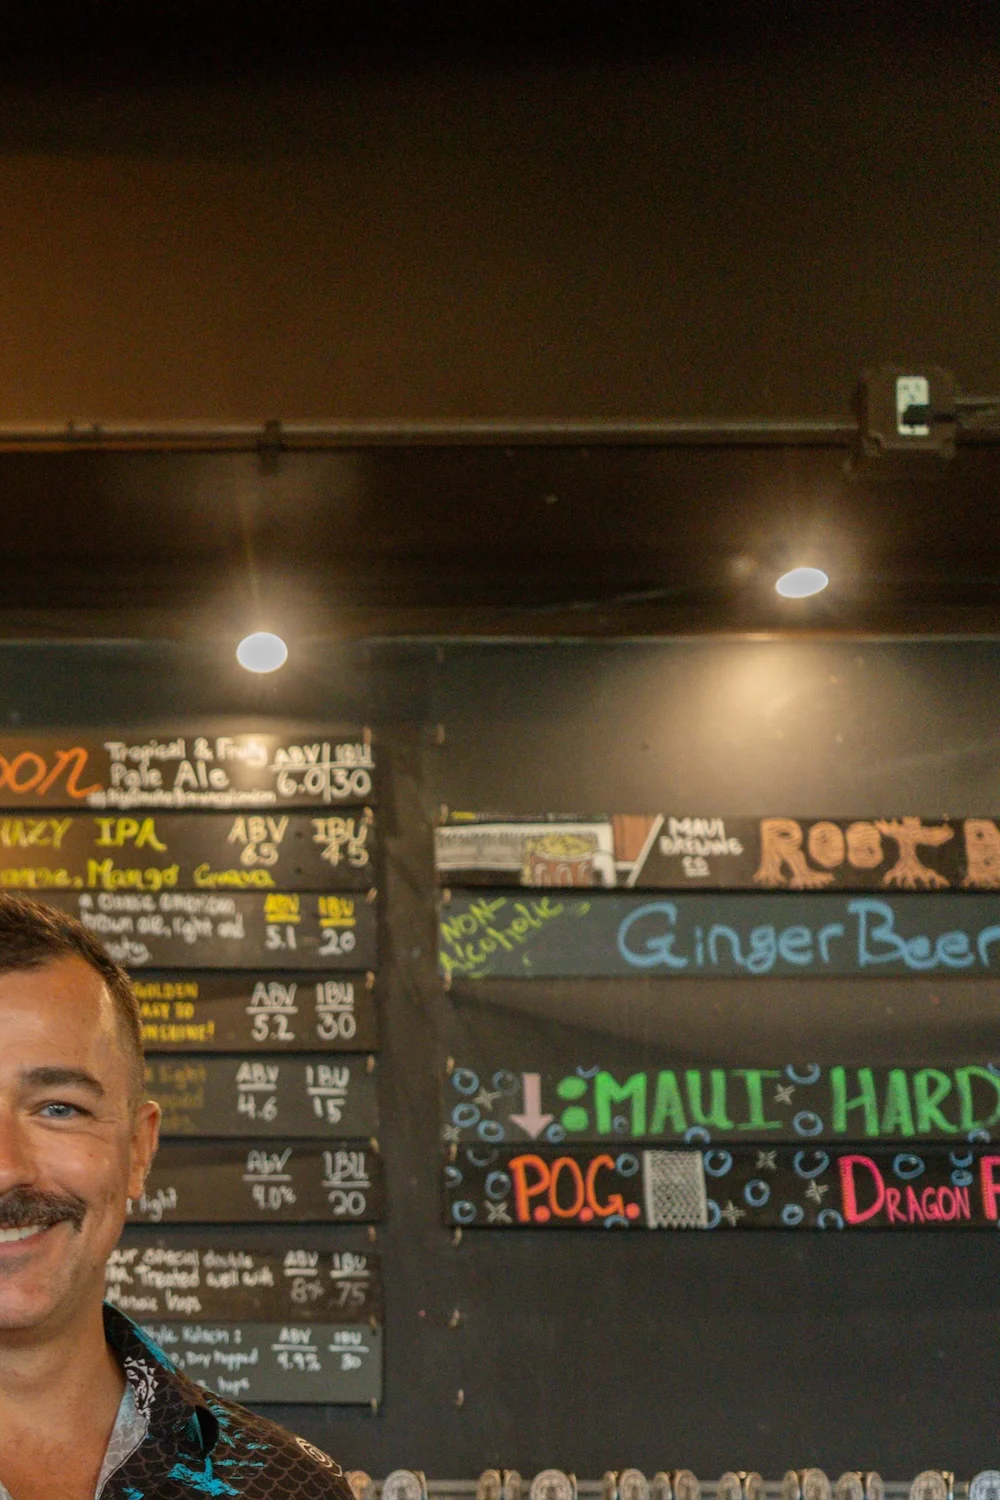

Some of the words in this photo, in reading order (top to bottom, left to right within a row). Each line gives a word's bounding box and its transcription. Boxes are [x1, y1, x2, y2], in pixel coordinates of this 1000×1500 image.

[105, 738, 186, 765] Tropical
[195, 738, 213, 759] &
[275, 744, 320, 763] ABV
[335, 743, 371, 763] IBU
[110, 762, 163, 787] Pale
[174, 760, 229, 789] Ale
[332, 768, 371, 797] 30
[95, 817, 167, 851] IPA
[228, 816, 289, 843] ABV
[312, 817, 368, 844] IBU
[753, 816, 955, 890] ROOT
[265, 893, 300, 913] ABV
[319, 896, 355, 915] IBU
[173, 915, 213, 944] light
[265, 926, 297, 950] 5.1
[319, 928, 355, 955] 20
[617, 901, 843, 973] Ginger
[848, 901, 1000, 969] Beer
[251, 981, 297, 1005] ABV
[316, 981, 354, 1005] IBU
[251, 1014, 294, 1041] 5.2
[316, 1012, 356, 1040] 30
[236, 1062, 279, 1083] ABV
[306, 1065, 349, 1088] IBU
[237, 1095, 278, 1122] 4.6
[313, 1097, 346, 1124] 15
[832, 1066, 1000, 1137] HARD
[323, 1152, 369, 1182] IBU
[328, 1190, 366, 1217] 20
[508, 1155, 641, 1223] P.O.G.
[284, 1250, 319, 1268] ABV
[333, 1252, 367, 1273] IBU
[135, 1265, 200, 1290] Treated
[206, 1270, 240, 1289] well
[242, 1268, 275, 1288] with
[336, 1281, 370, 1308] 75
[279, 1327, 311, 1345] ABV
[334, 1331, 362, 1345] IBU
